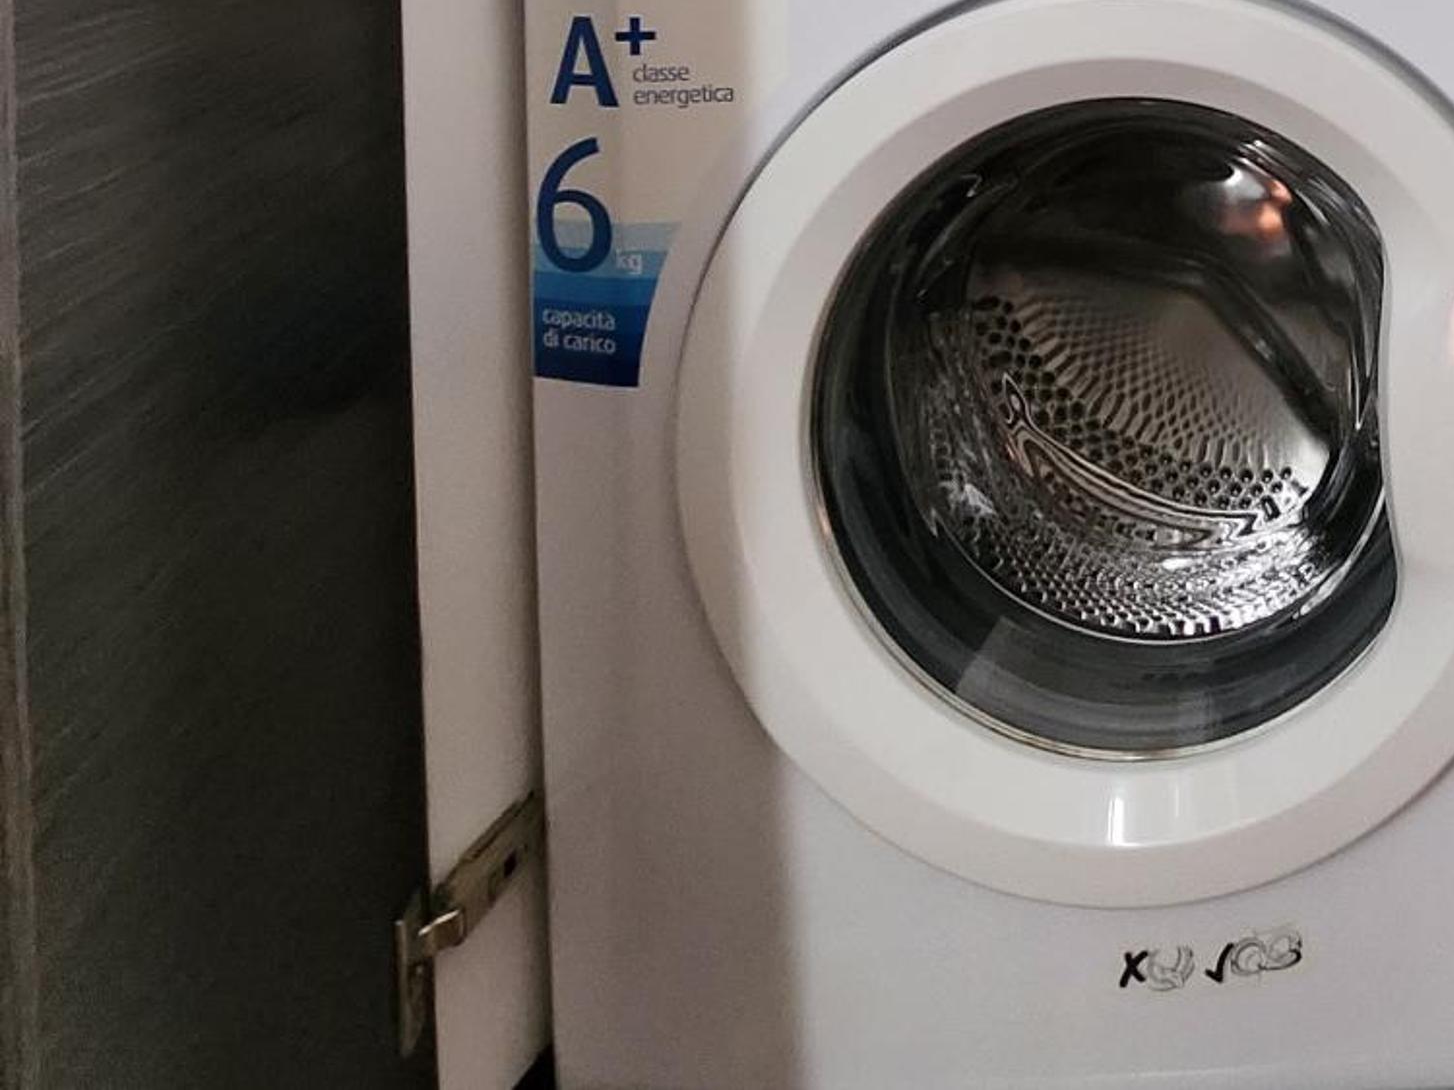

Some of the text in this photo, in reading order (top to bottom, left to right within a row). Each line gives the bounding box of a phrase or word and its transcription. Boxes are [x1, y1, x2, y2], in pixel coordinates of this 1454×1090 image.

[549, 15, 656, 108] A+
[632, 63, 690, 84] classe
[633, 86, 735, 109] energetica
[535, 136, 643, 275] 6 kg
[542, 327, 617, 356] di carico
